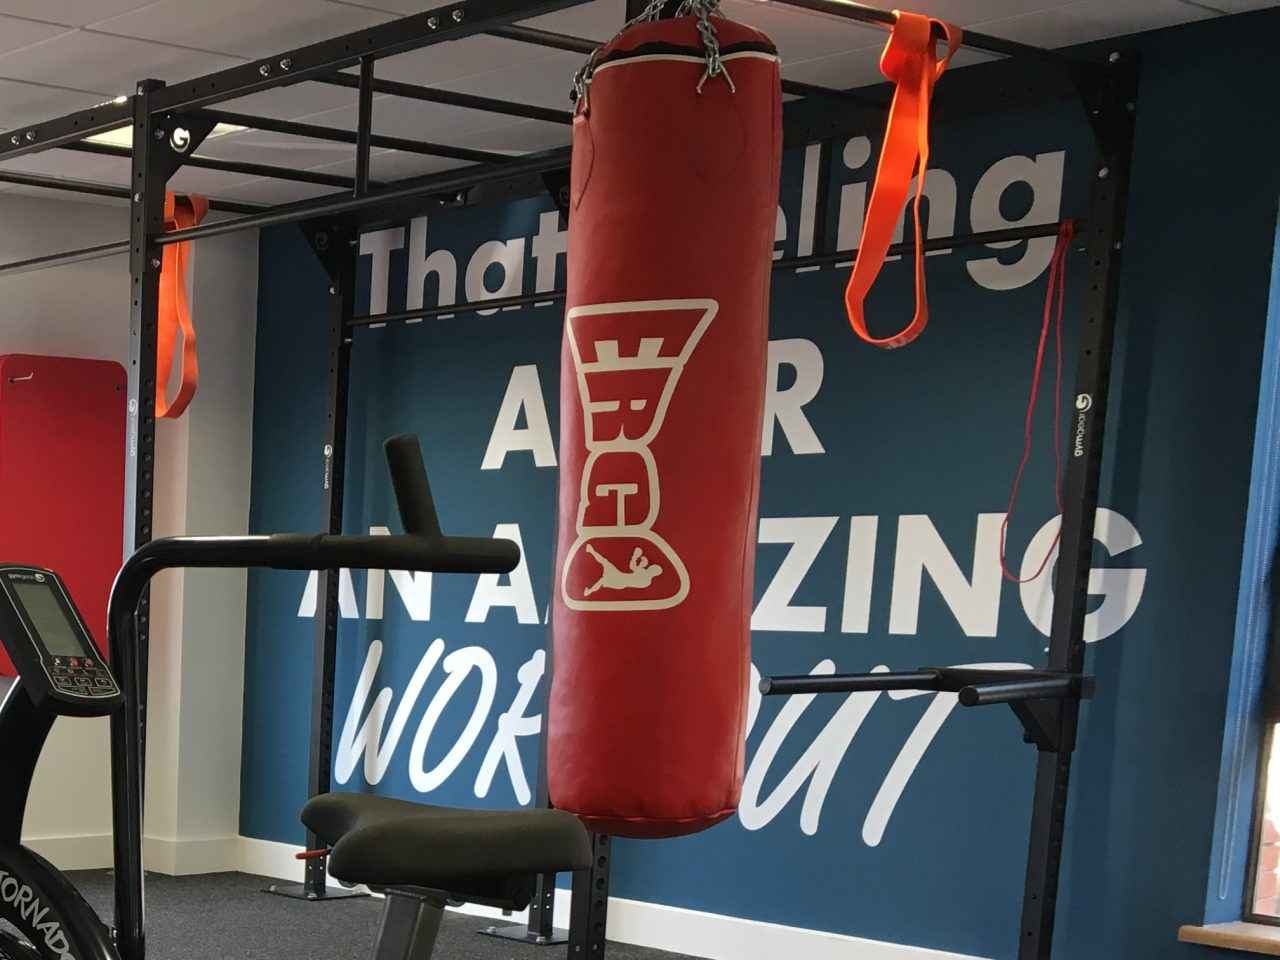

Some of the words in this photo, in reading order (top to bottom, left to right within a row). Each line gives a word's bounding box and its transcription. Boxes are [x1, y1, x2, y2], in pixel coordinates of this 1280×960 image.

[359, 210, 569, 328] That
[772, 135, 1066, 291] ling
[464, 506, 1148, 644] AZING
[334, 637, 1035, 848] WORUT
